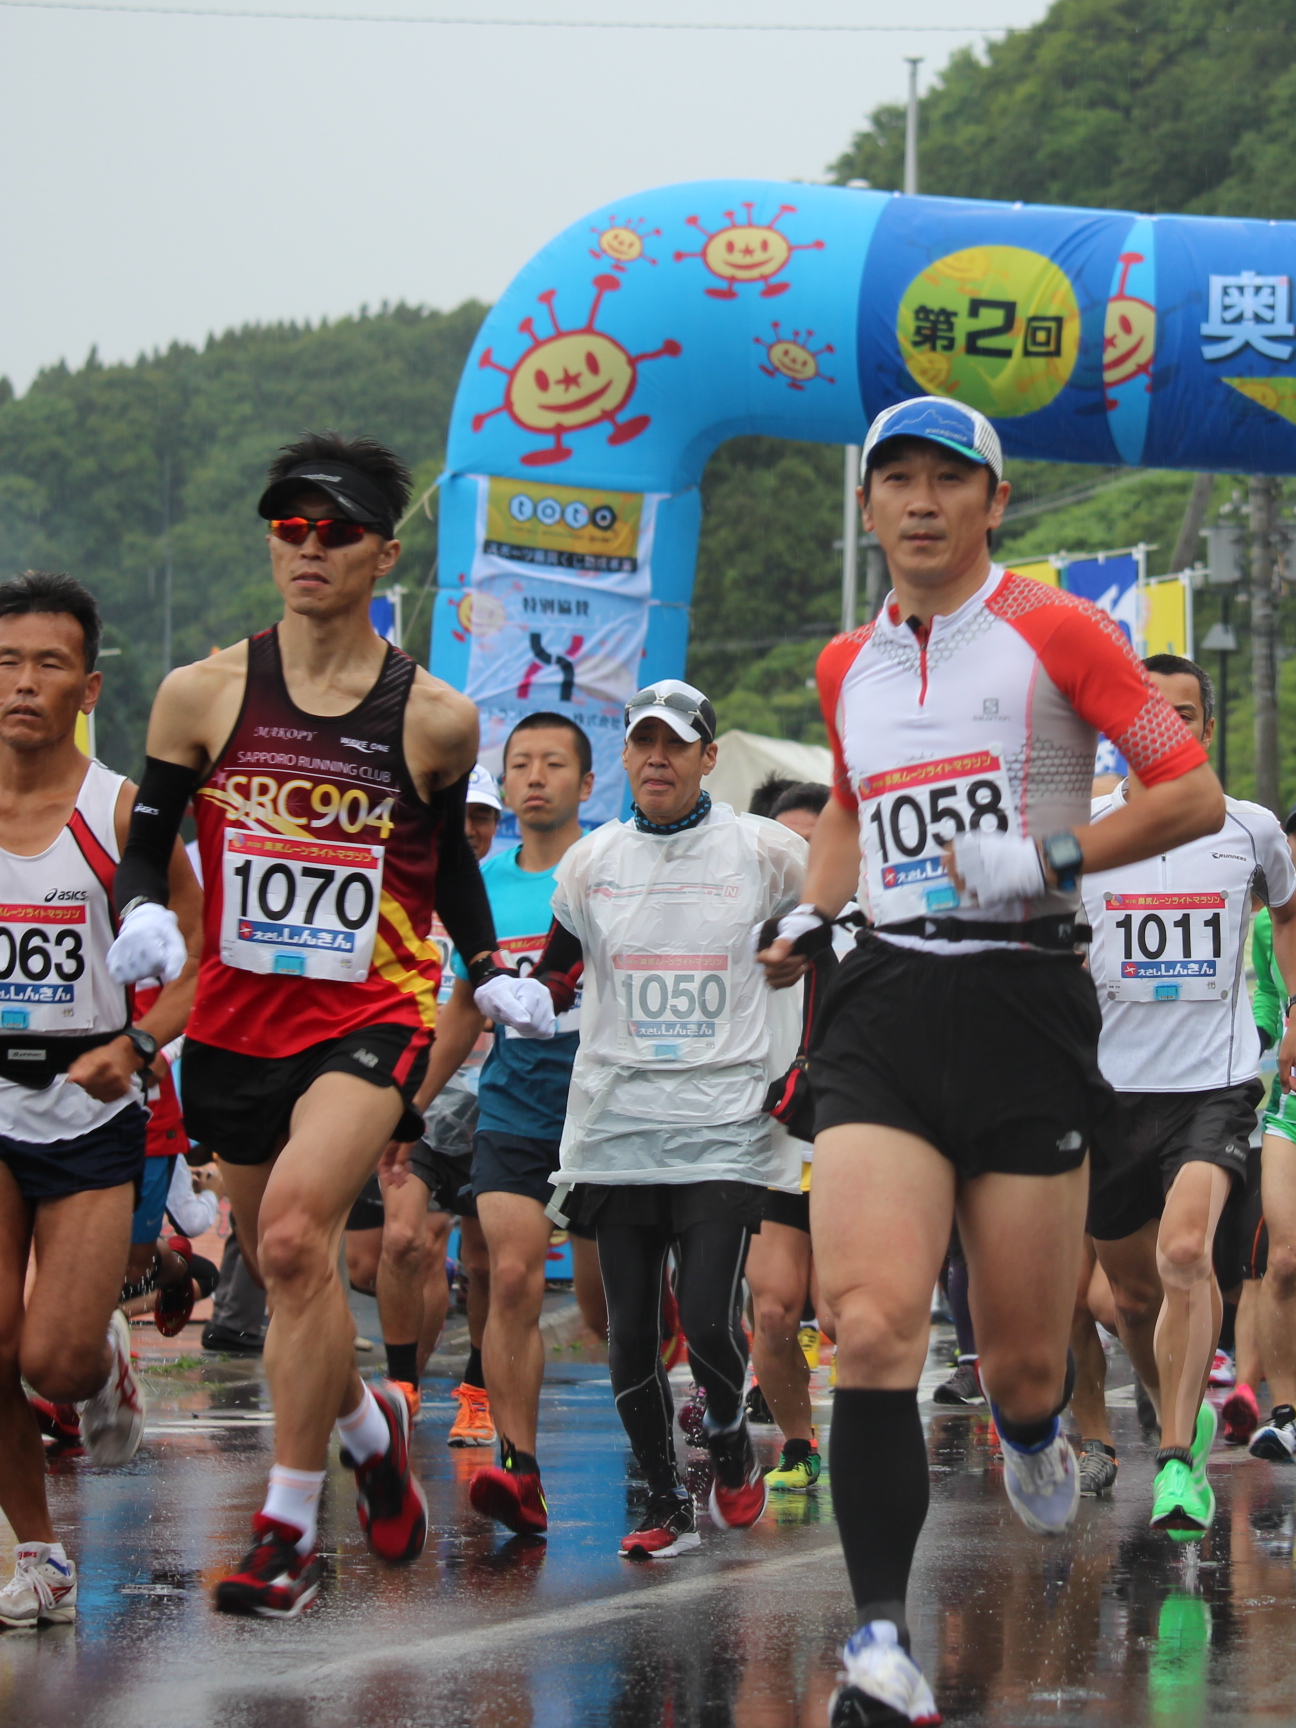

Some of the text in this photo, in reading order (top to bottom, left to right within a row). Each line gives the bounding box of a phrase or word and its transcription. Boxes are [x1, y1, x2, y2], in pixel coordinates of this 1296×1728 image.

[911, 297, 1063, 360] 第2回
[509, 493, 617, 531] toto
[237, 751, 392, 783] SAPPORO RUNNING CLUB
[225, 774, 395, 839] SRC904
[869, 779, 1009, 864] 1058
[233, 858, 374, 931] 1070
[1115, 912, 1222, 960] 1011
[1138, 963, 1214, 976] えさししんきん
[621, 973, 727, 1020] 1050
